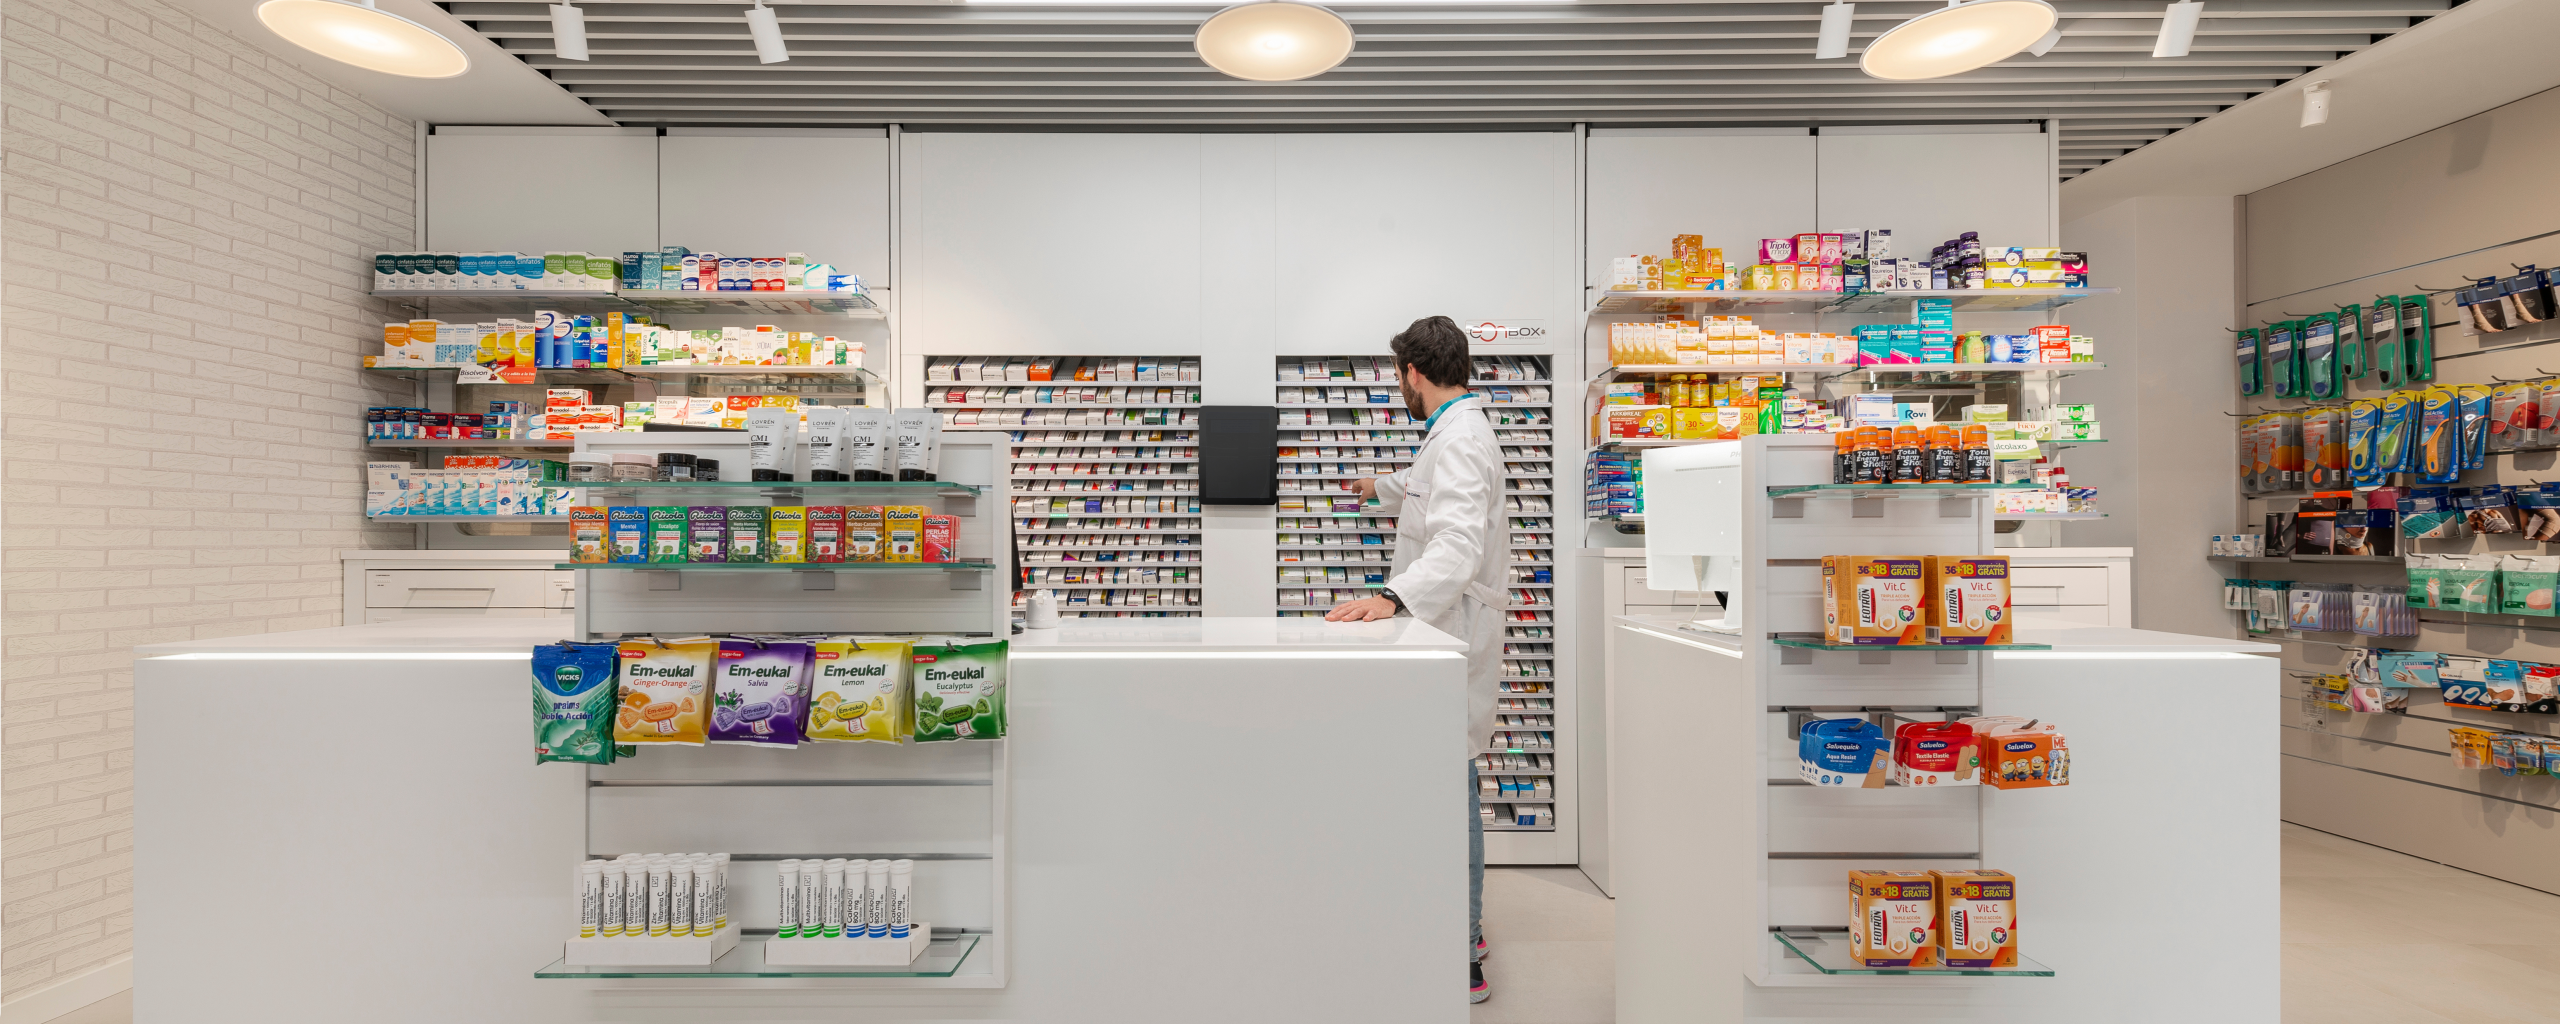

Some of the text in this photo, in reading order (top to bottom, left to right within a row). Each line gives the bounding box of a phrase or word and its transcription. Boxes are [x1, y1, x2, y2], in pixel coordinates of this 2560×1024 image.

[1770, 241, 1790, 250] Tripto
[571, 511, 605, 520] Ricola
[611, 511, 644, 520] Ricola
[651, 510, 685, 519] Ricola
[690, 510, 723, 519] Ricola
[729, 510, 762, 519] Ricola
[772, 511, 802, 520] Ricola
[809, 511, 841, 520] Ricola
[848, 510, 880, 519] Ricola
[887, 510, 919, 519] Ricola
[630, 664, 694, 677] Em-eukal
[729, 664, 791, 678] Em-eukal
[824, 664, 886, 676] Em-eukal
[925, 666, 984, 680] Em-eukal
[634, 679, 687, 688] Ginger-Orange
[937, 683, 973, 691] Eucalyptus
[553, 702, 580, 711] praims
[2054, 739, 2065, 748] ME
